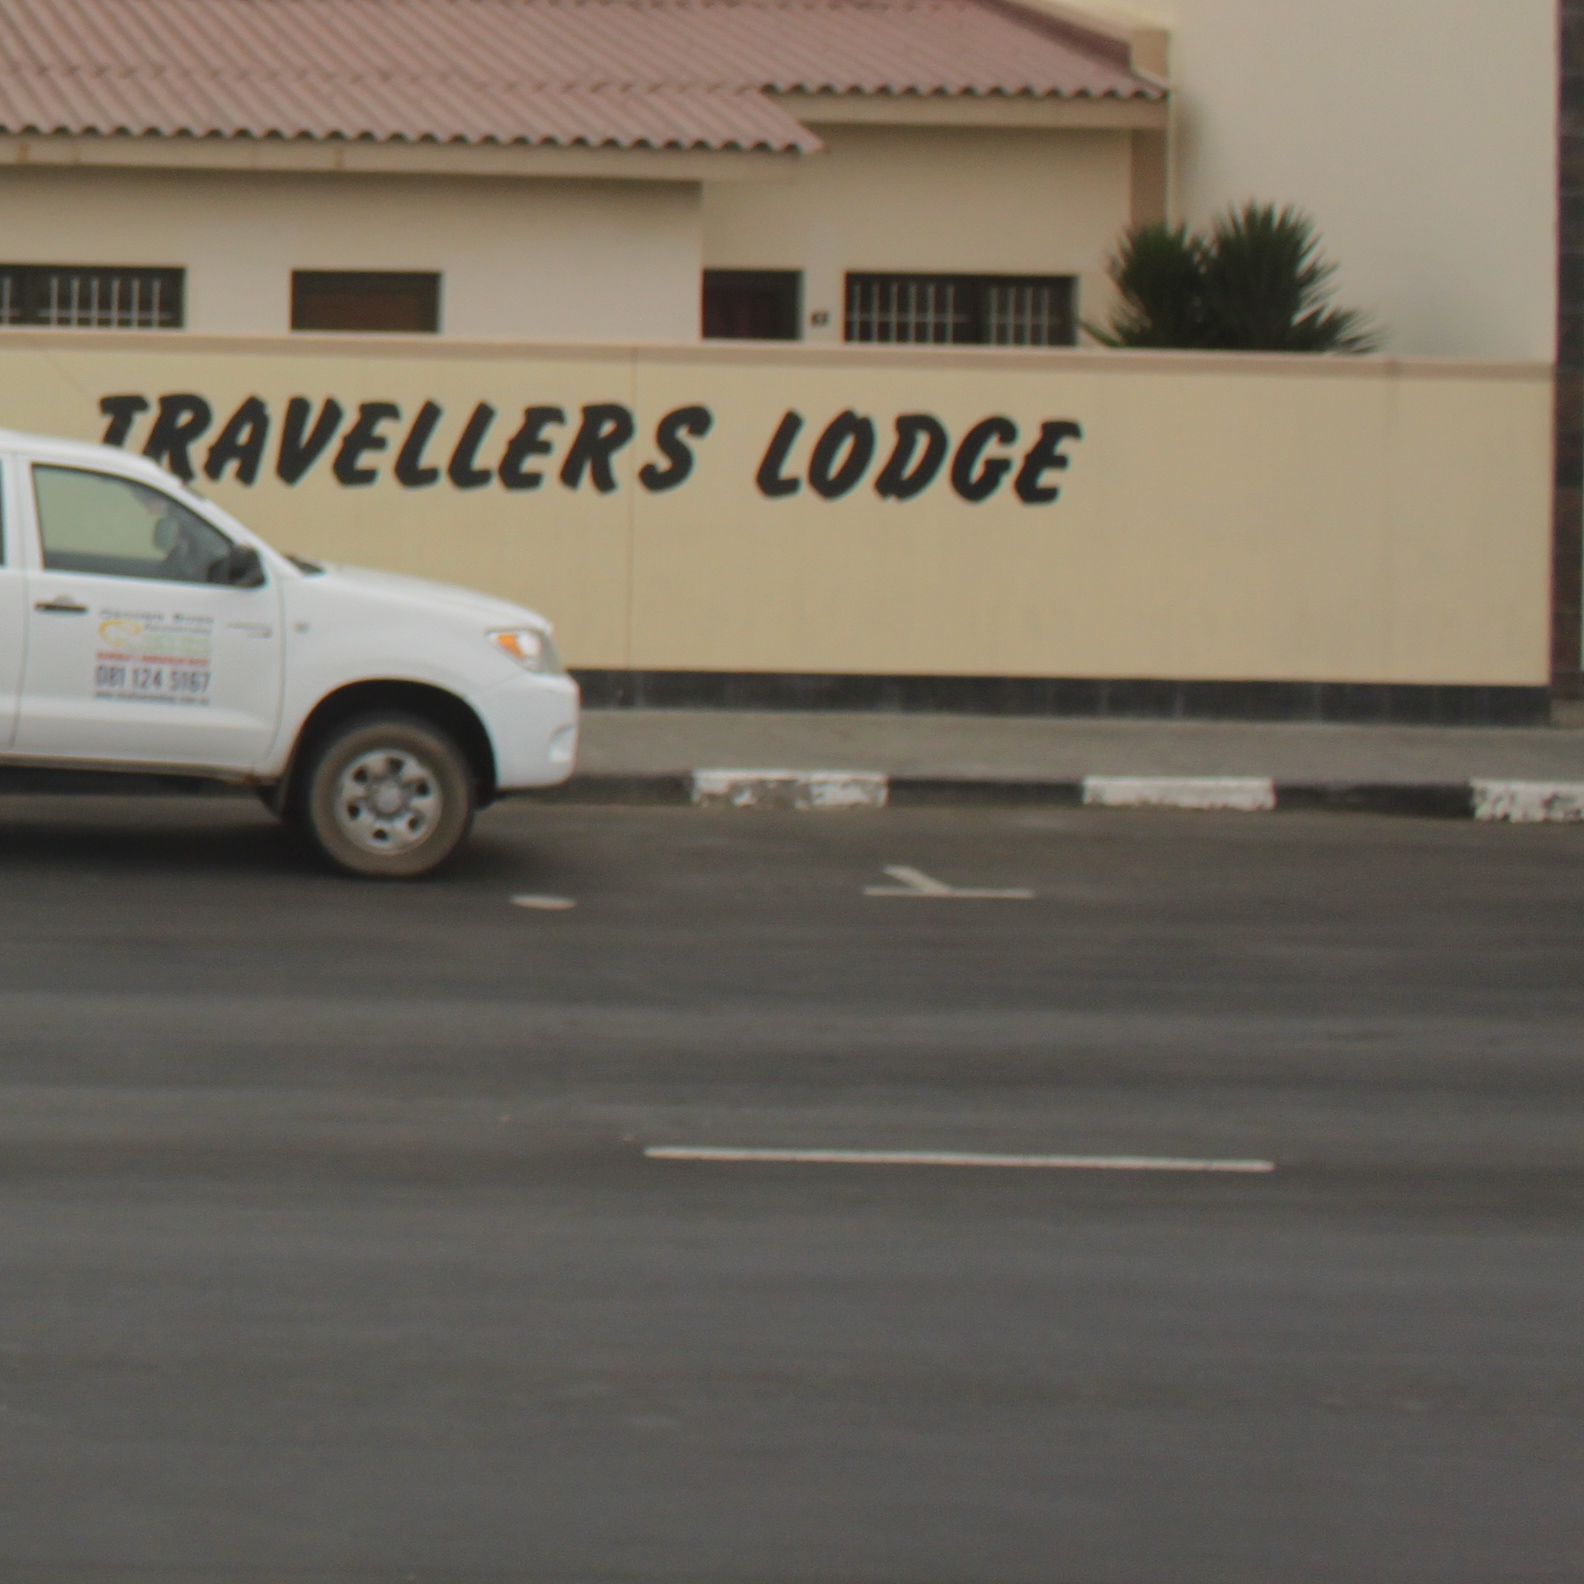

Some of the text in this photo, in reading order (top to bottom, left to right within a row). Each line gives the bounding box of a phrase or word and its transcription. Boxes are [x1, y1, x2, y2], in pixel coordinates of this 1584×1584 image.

[98, 392, 1082, 505] TRAVELLERS LODGE
[132, 667, 163, 690] 124
